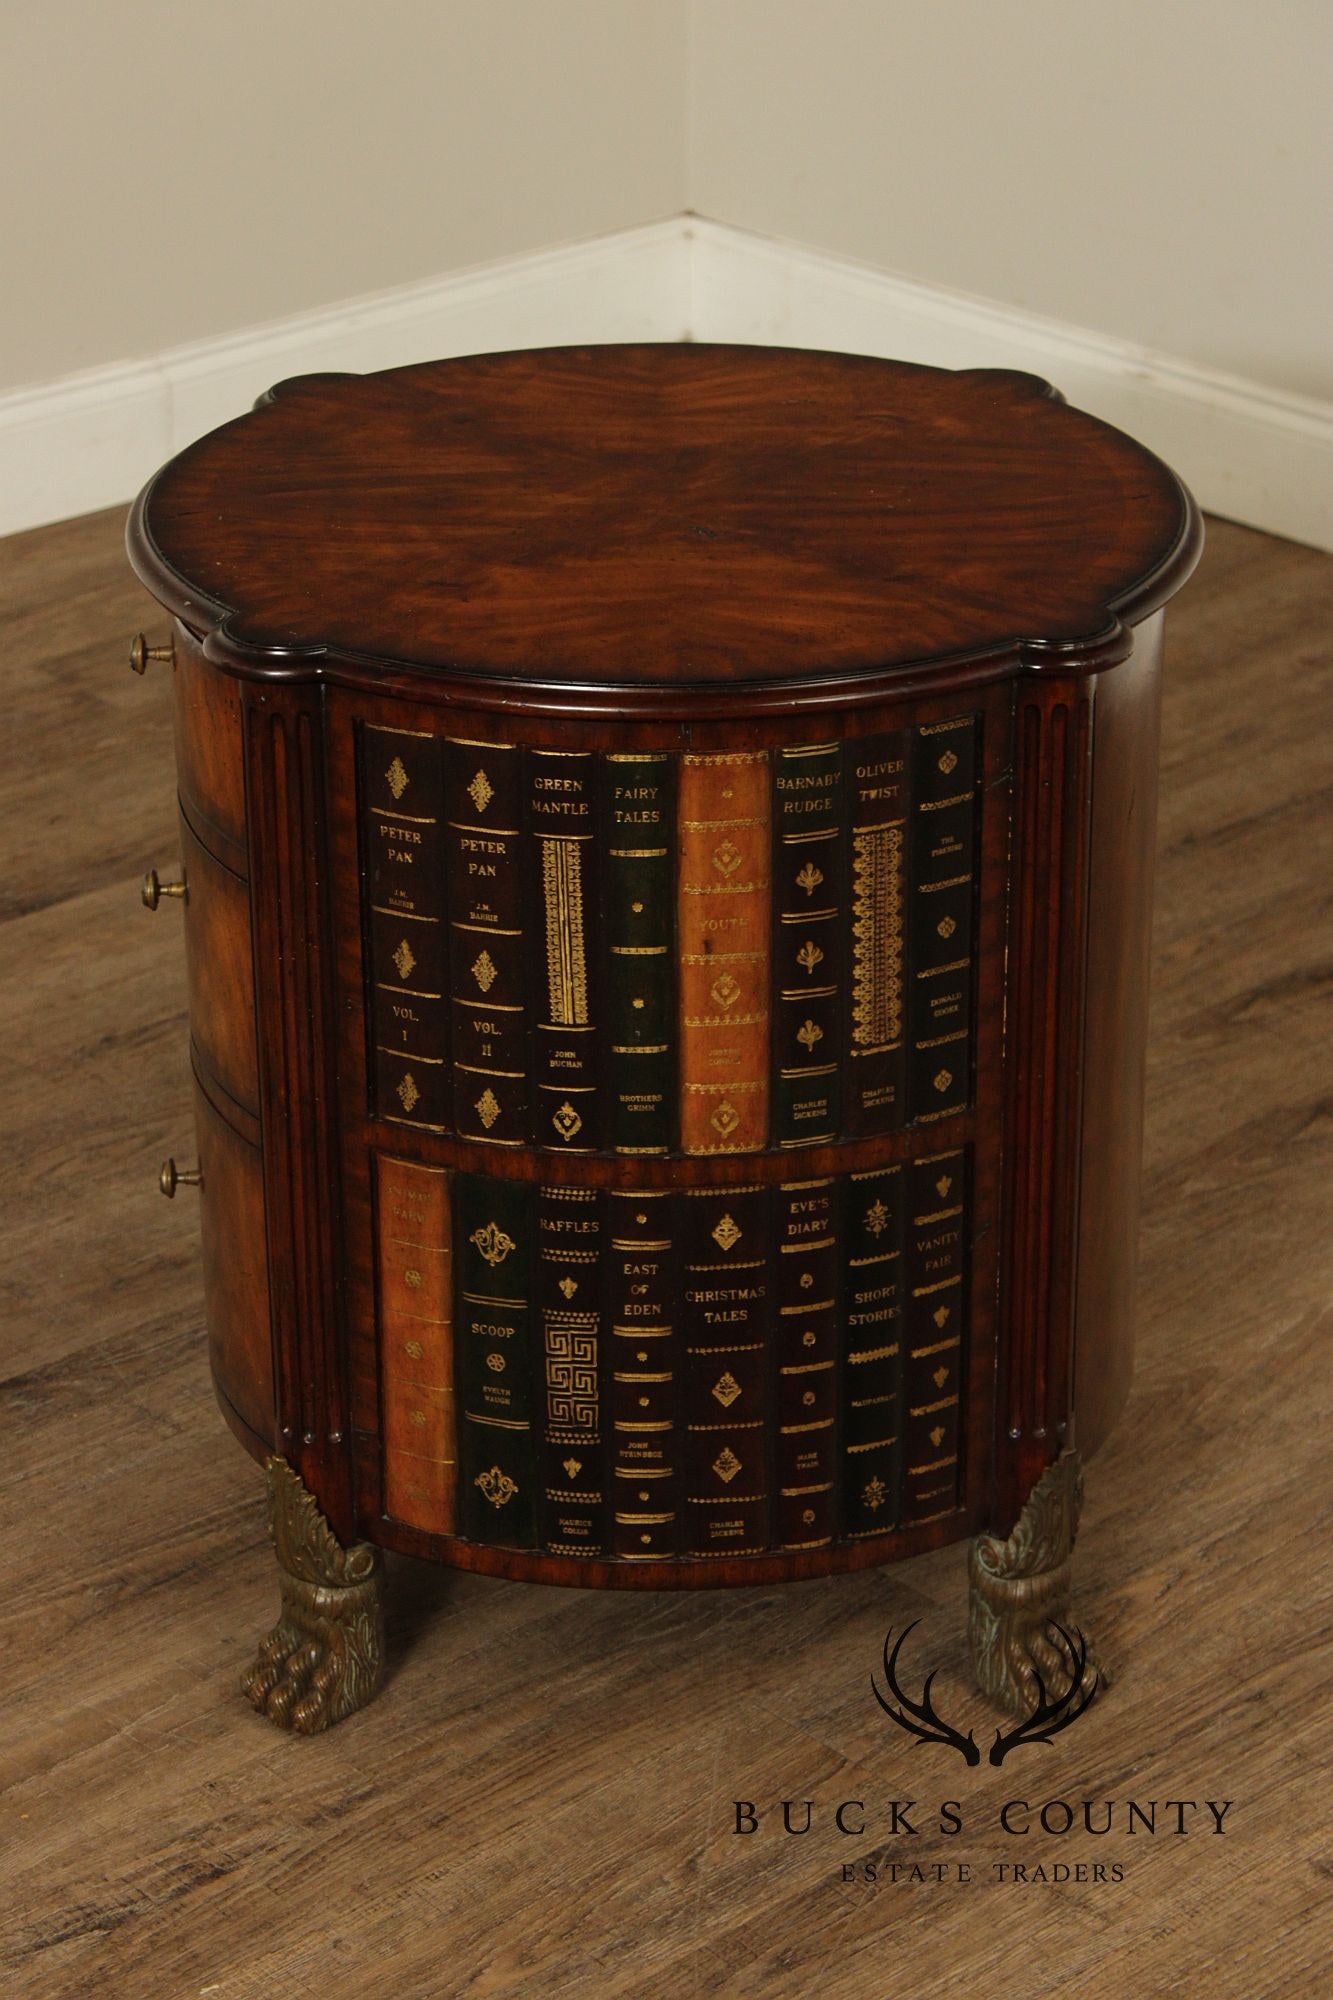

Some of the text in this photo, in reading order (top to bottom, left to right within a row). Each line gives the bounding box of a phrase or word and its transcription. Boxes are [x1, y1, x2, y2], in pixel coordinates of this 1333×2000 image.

[856, 760, 904, 778] OLIVER
[534, 777, 583, 792] GREEN
[776, 772, 840, 790] BARNABY
[615, 788, 659, 799] FAIRY
[859, 785, 900, 801] TWIST
[532, 800, 589, 815] MANTLE
[784, 799, 833, 813] RUDGE
[614, 811, 660, 823] TALES
[380, 825, 422, 844] PETER
[461, 839, 506, 854] PETER
[388, 849, 413, 863] PAN
[469, 863, 496, 876] PAN
[700, 918, 750, 932] YOUTH
[393, 1006, 420, 1022] VOL.
[473, 1021, 502, 1035] VOL.
[555, 1050, 577, 1058] JOHN
[549, 1059, 583, 1068] BUCHAN
[619, 1094, 662, 1102] BROTHERS
[793, 1099, 828, 1111] CHARLES
[627, 1104, 655, 1112] GRIMM
[793, 1108, 828, 1120] DICKENS
[790, 1198, 829, 1214] EVE'S
[540, 1218, 599, 1233] RAFFLES
[787, 1219, 829, 1235] DIARY
[917, 1231, 960, 1251] VANITY
[624, 1264, 658, 1275] EAST
[925, 1255, 952, 1272] FAIR
[631, 1284, 649, 1295] OF
[685, 1286, 766, 1303] CHRISTMAS
[855, 1284, 897, 1304] SHORT
[624, 1304, 661, 1316] EDEN
[704, 1310, 748, 1323] TALES
[848, 1306, 901, 1325] STORIES
[471, 1323, 515, 1338] SCOOP
